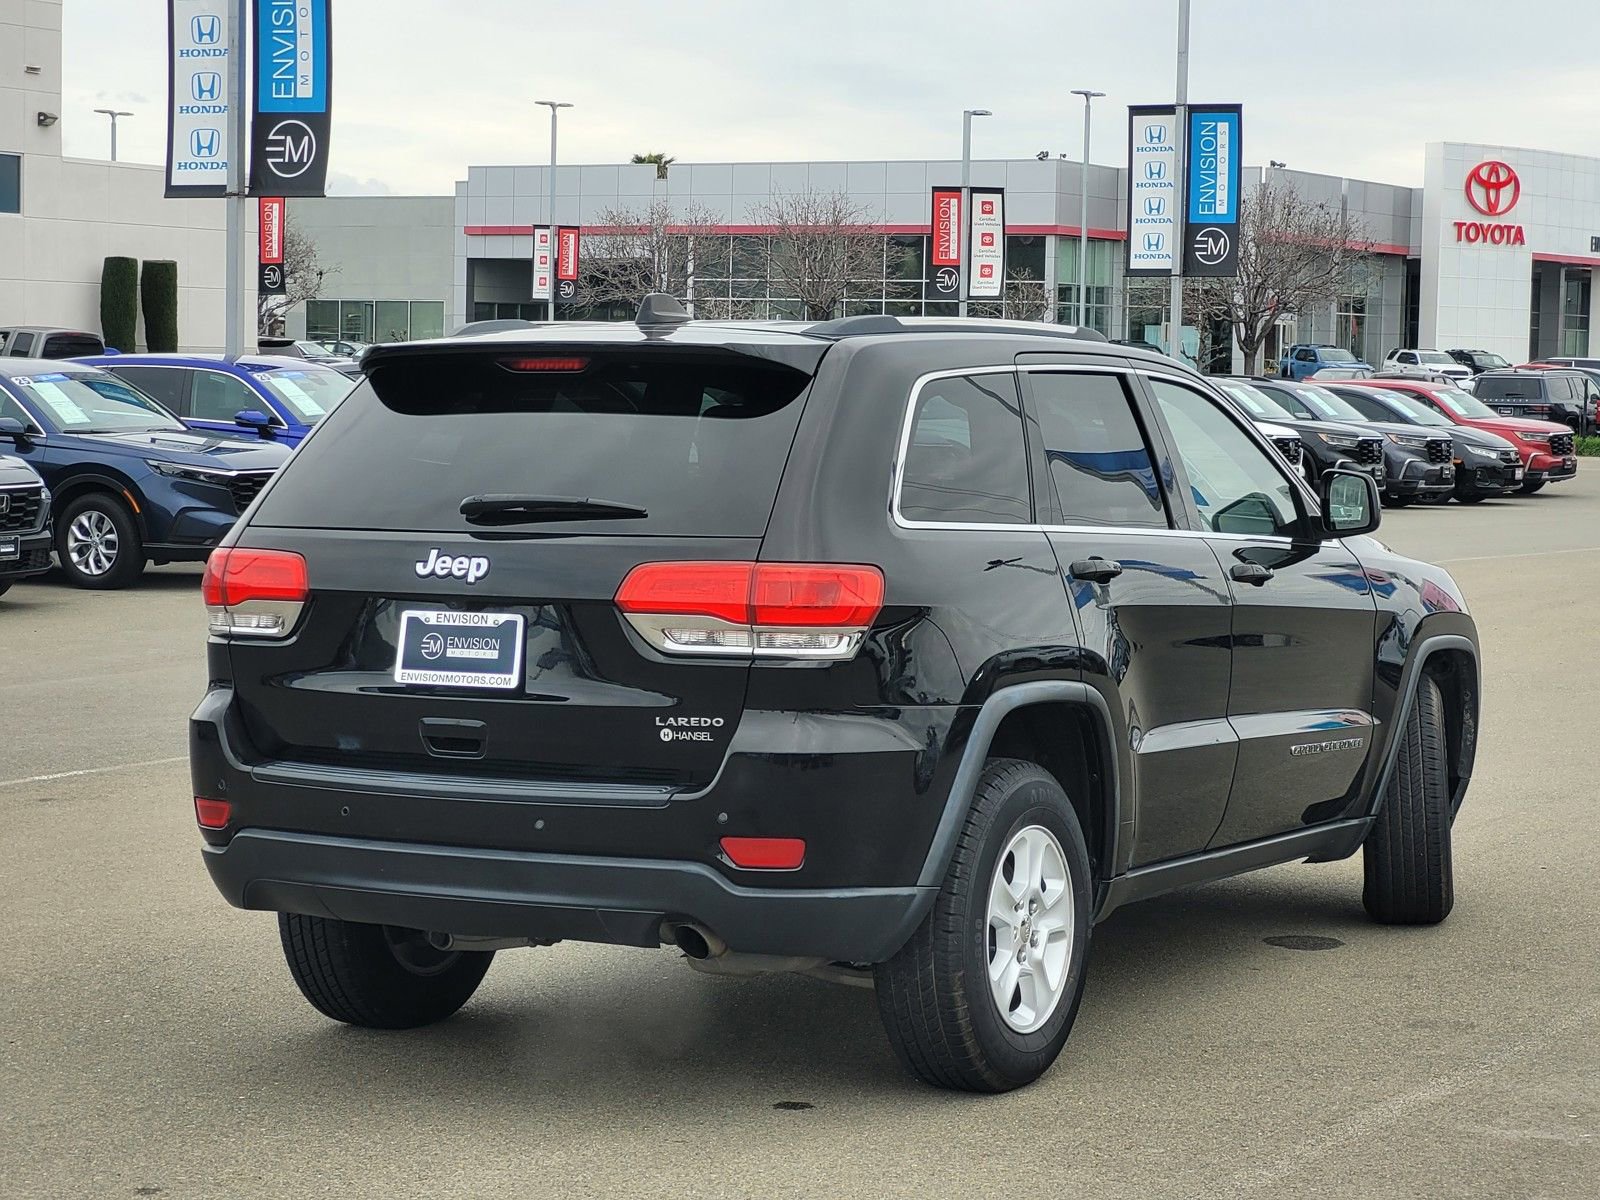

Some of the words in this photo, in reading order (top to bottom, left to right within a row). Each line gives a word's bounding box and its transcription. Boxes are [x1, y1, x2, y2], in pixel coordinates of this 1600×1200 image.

[179, 48, 228, 57] HONDA
[179, 105, 228, 114] HONDA
[176, 161, 227, 170] HONDA
[1199, 121, 1216, 215] ENVISION
[1219, 130, 1227, 206] MOTORS
[264, 203, 273, 258] ENVISION
[939, 198, 950, 259] ENVISION
[1453, 222, 1525, 246] TOYOTA
[561, 233, 570, 275] ENVISION
[415, 548, 490, 584] Jeep
[436, 613, 488, 625] ENVISION
[447, 636, 500, 650] ENVISION
[400, 672, 512, 687] ENVISIONMOTORS.COM
[655, 717, 724, 727] LAREDO
[673, 731, 714, 741] HANSEL
